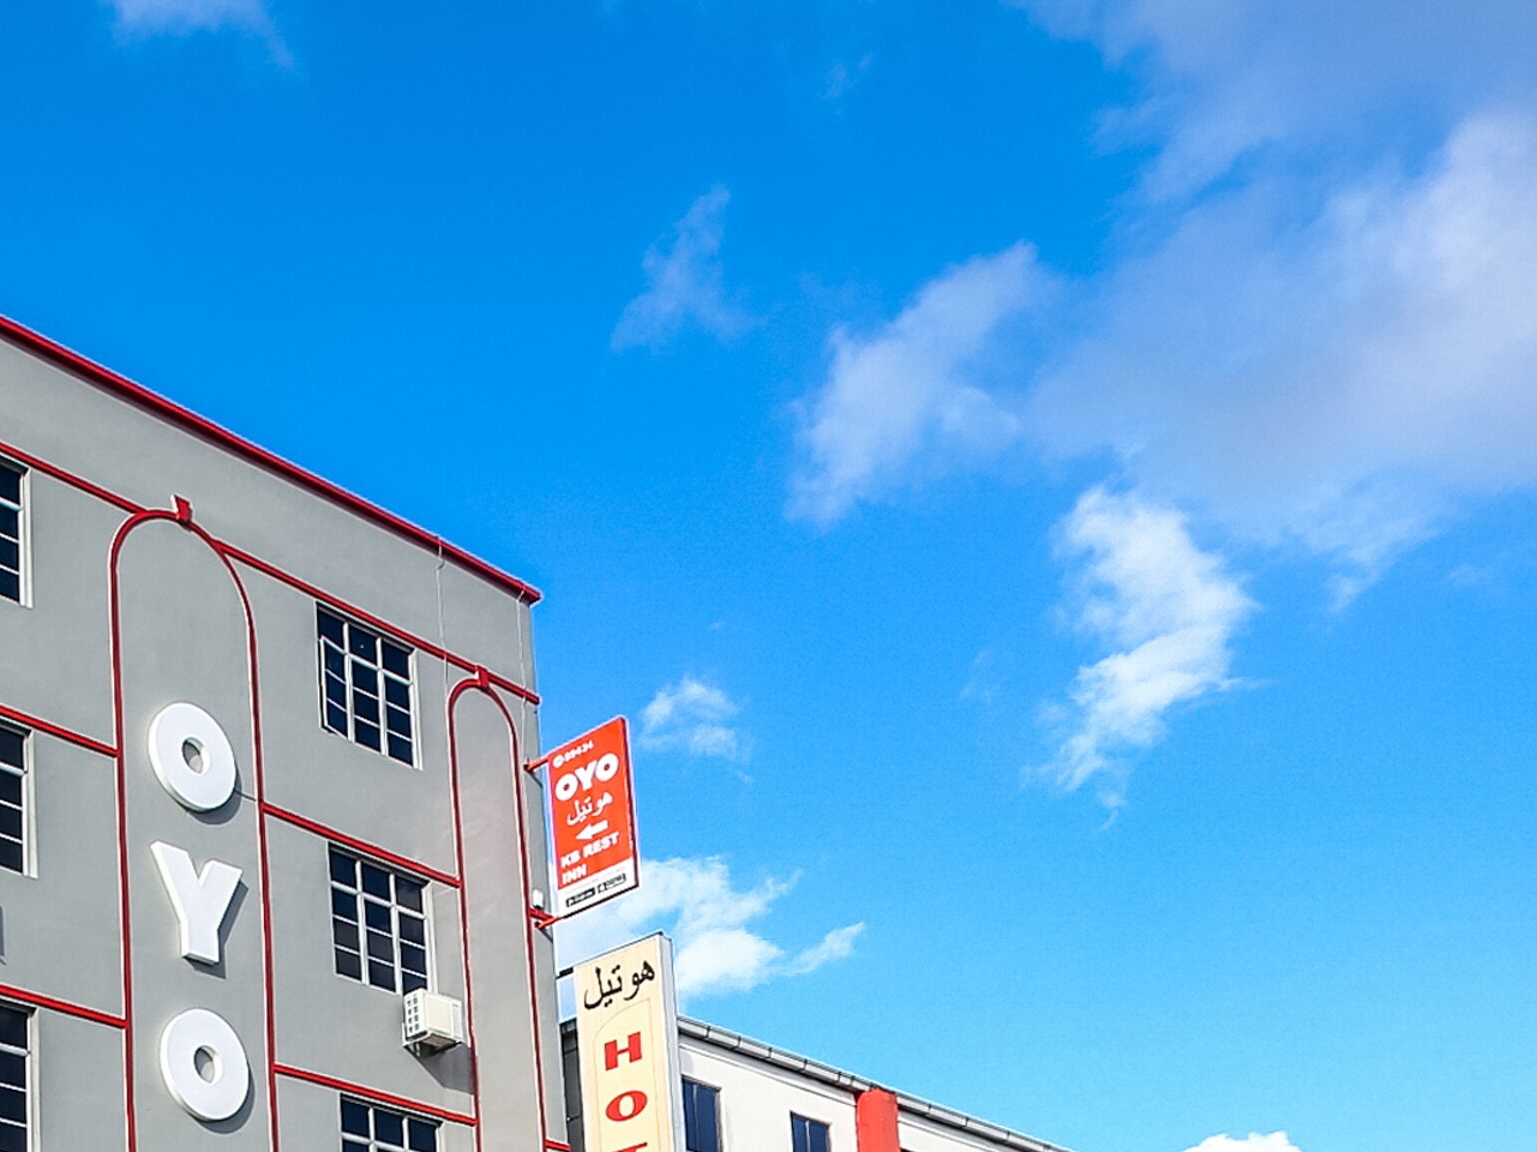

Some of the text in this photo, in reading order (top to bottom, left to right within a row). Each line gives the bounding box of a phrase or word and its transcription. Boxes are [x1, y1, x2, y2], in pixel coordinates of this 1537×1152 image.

[555, 753, 619, 801] OYO
[560, 832, 620, 868] KB REST
[562, 864, 588, 885] INN
[147, 701, 250, 1122] OYO
